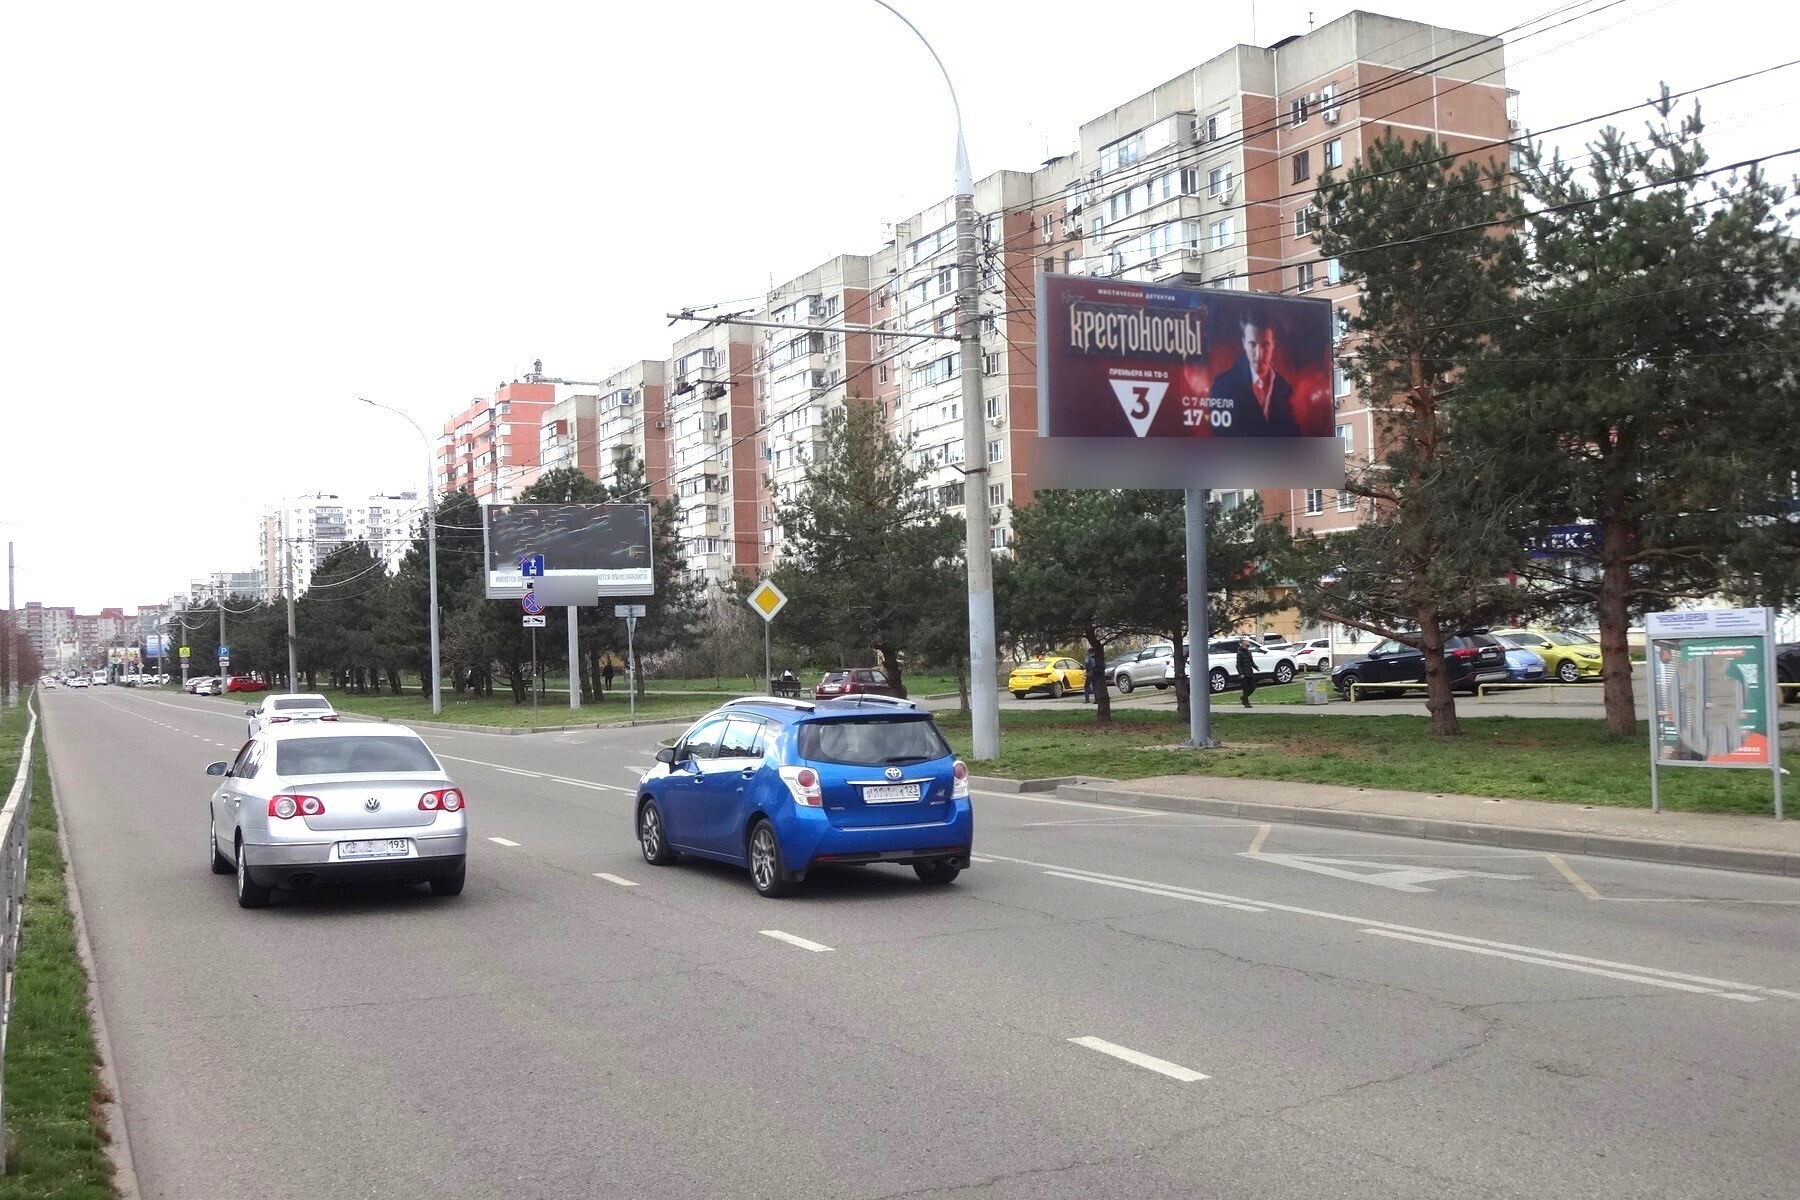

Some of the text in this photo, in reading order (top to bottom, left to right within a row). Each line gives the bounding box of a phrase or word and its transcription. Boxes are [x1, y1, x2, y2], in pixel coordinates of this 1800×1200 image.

[1097, 288, 1176, 302] МИСТИЧЕСКИЙ ДЕТЕКТИВ
[1109, 368, 1169, 379] ПРЕМЬЕРА НА ТВ-3
[1130, 386, 1151, 420] 3
[1182, 396, 1235, 409] С 7 АПРЕЛЯ
[1183, 409, 1232, 428] 17 00
[904, 785, 919, 794] 123
[388, 839, 406, 849] 193
